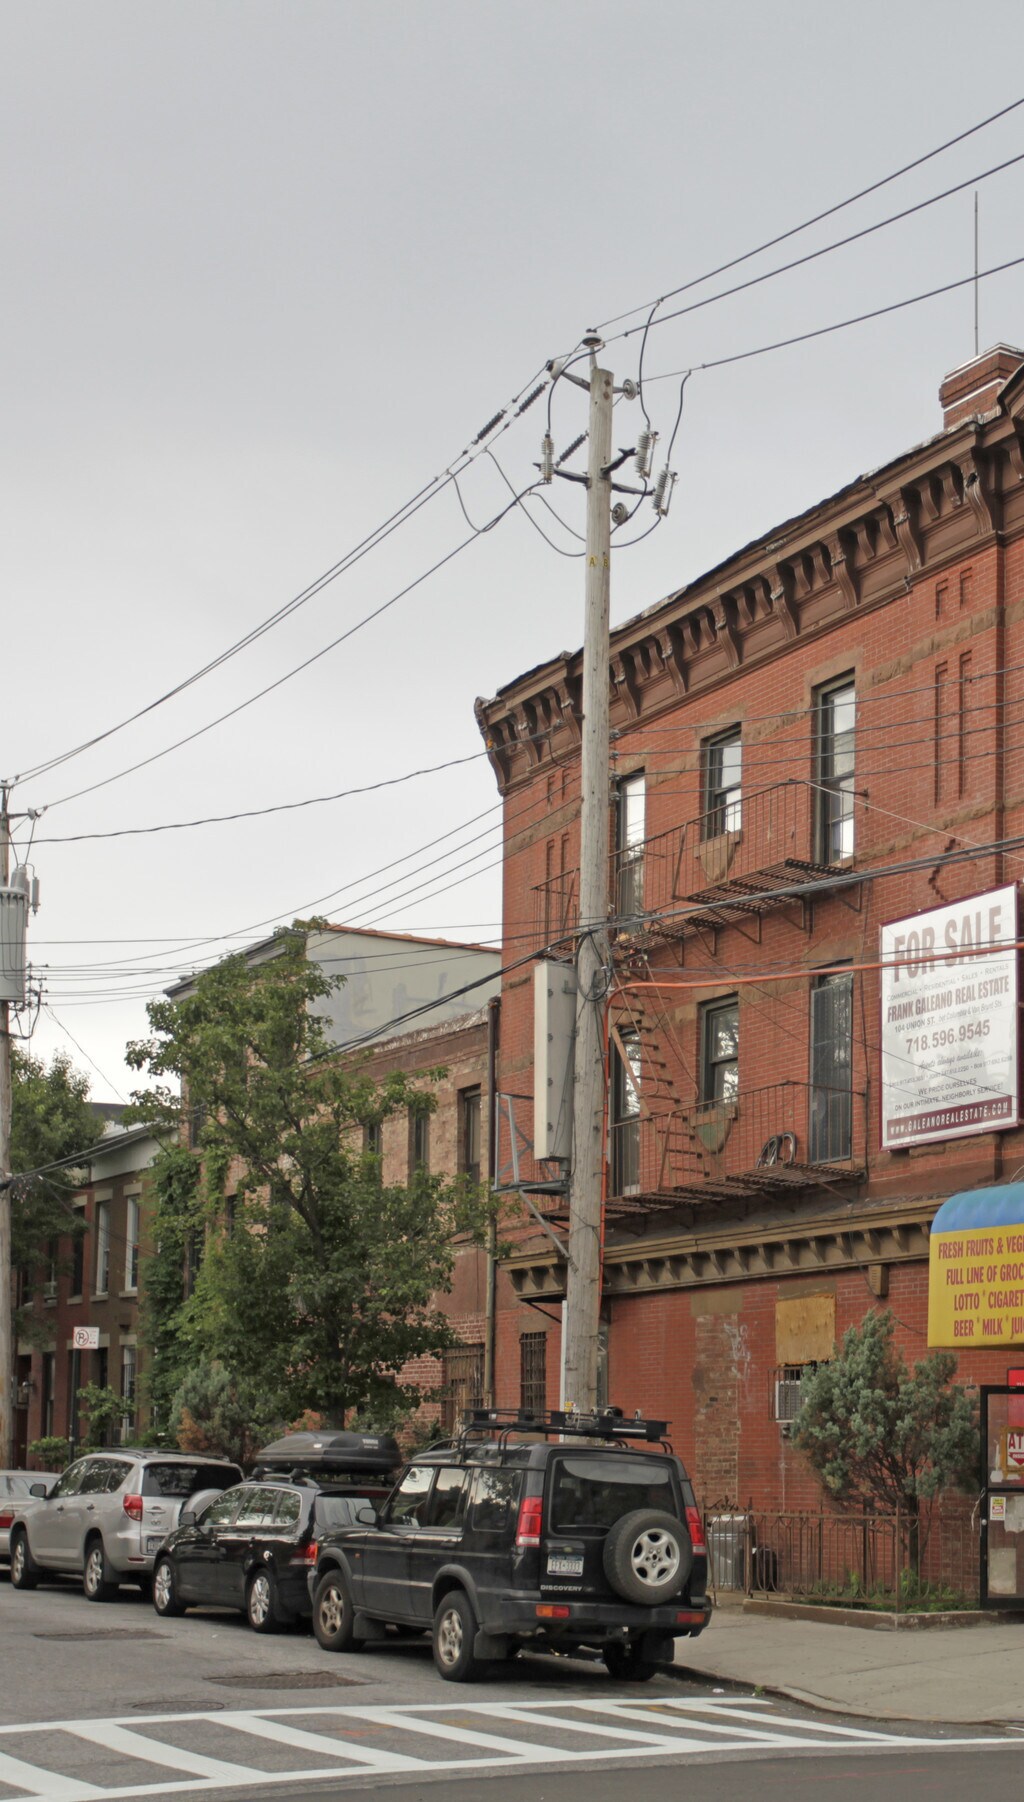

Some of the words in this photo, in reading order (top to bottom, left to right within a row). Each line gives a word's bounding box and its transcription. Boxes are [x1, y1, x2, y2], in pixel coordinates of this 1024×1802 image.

[894, 926, 935, 983] FOR
[944, 905, 1002, 968] SALE
[888, 1001, 914, 1022] FRANK
[916, 990, 952, 1015] GALEANO
[956, 984, 976, 1005] REAL
[978, 976, 1009, 999] ESTATE
[894, 1024, 904, 1033] 104
[906, 1018, 925, 1030] UNION
[927, 1016, 936, 1026] ST.
[906, 1020, 990, 1054] 718.596.9545
[928, 1084, 944, 1094] PRIDE
[945, 1078, 976, 1090] OURSELVES
[903, 1102, 914, 1110] OUR
[942, 1090, 976, 1102] NEIGHBORLY
[938, 1242, 963, 1260] FRESH
[966, 1238, 994, 1256] FRUITS
[996, 1237, 1003, 1254] &
[946, 1268, 964, 1285] FULL
[967, 1266, 984, 1284] LINE
[987, 1265, 998, 1283] OF
[954, 1292, 979, 1311] LOTTO
[954, 1320, 974, 1337] BEER
[982, 1318, 1003, 1336] MILK
